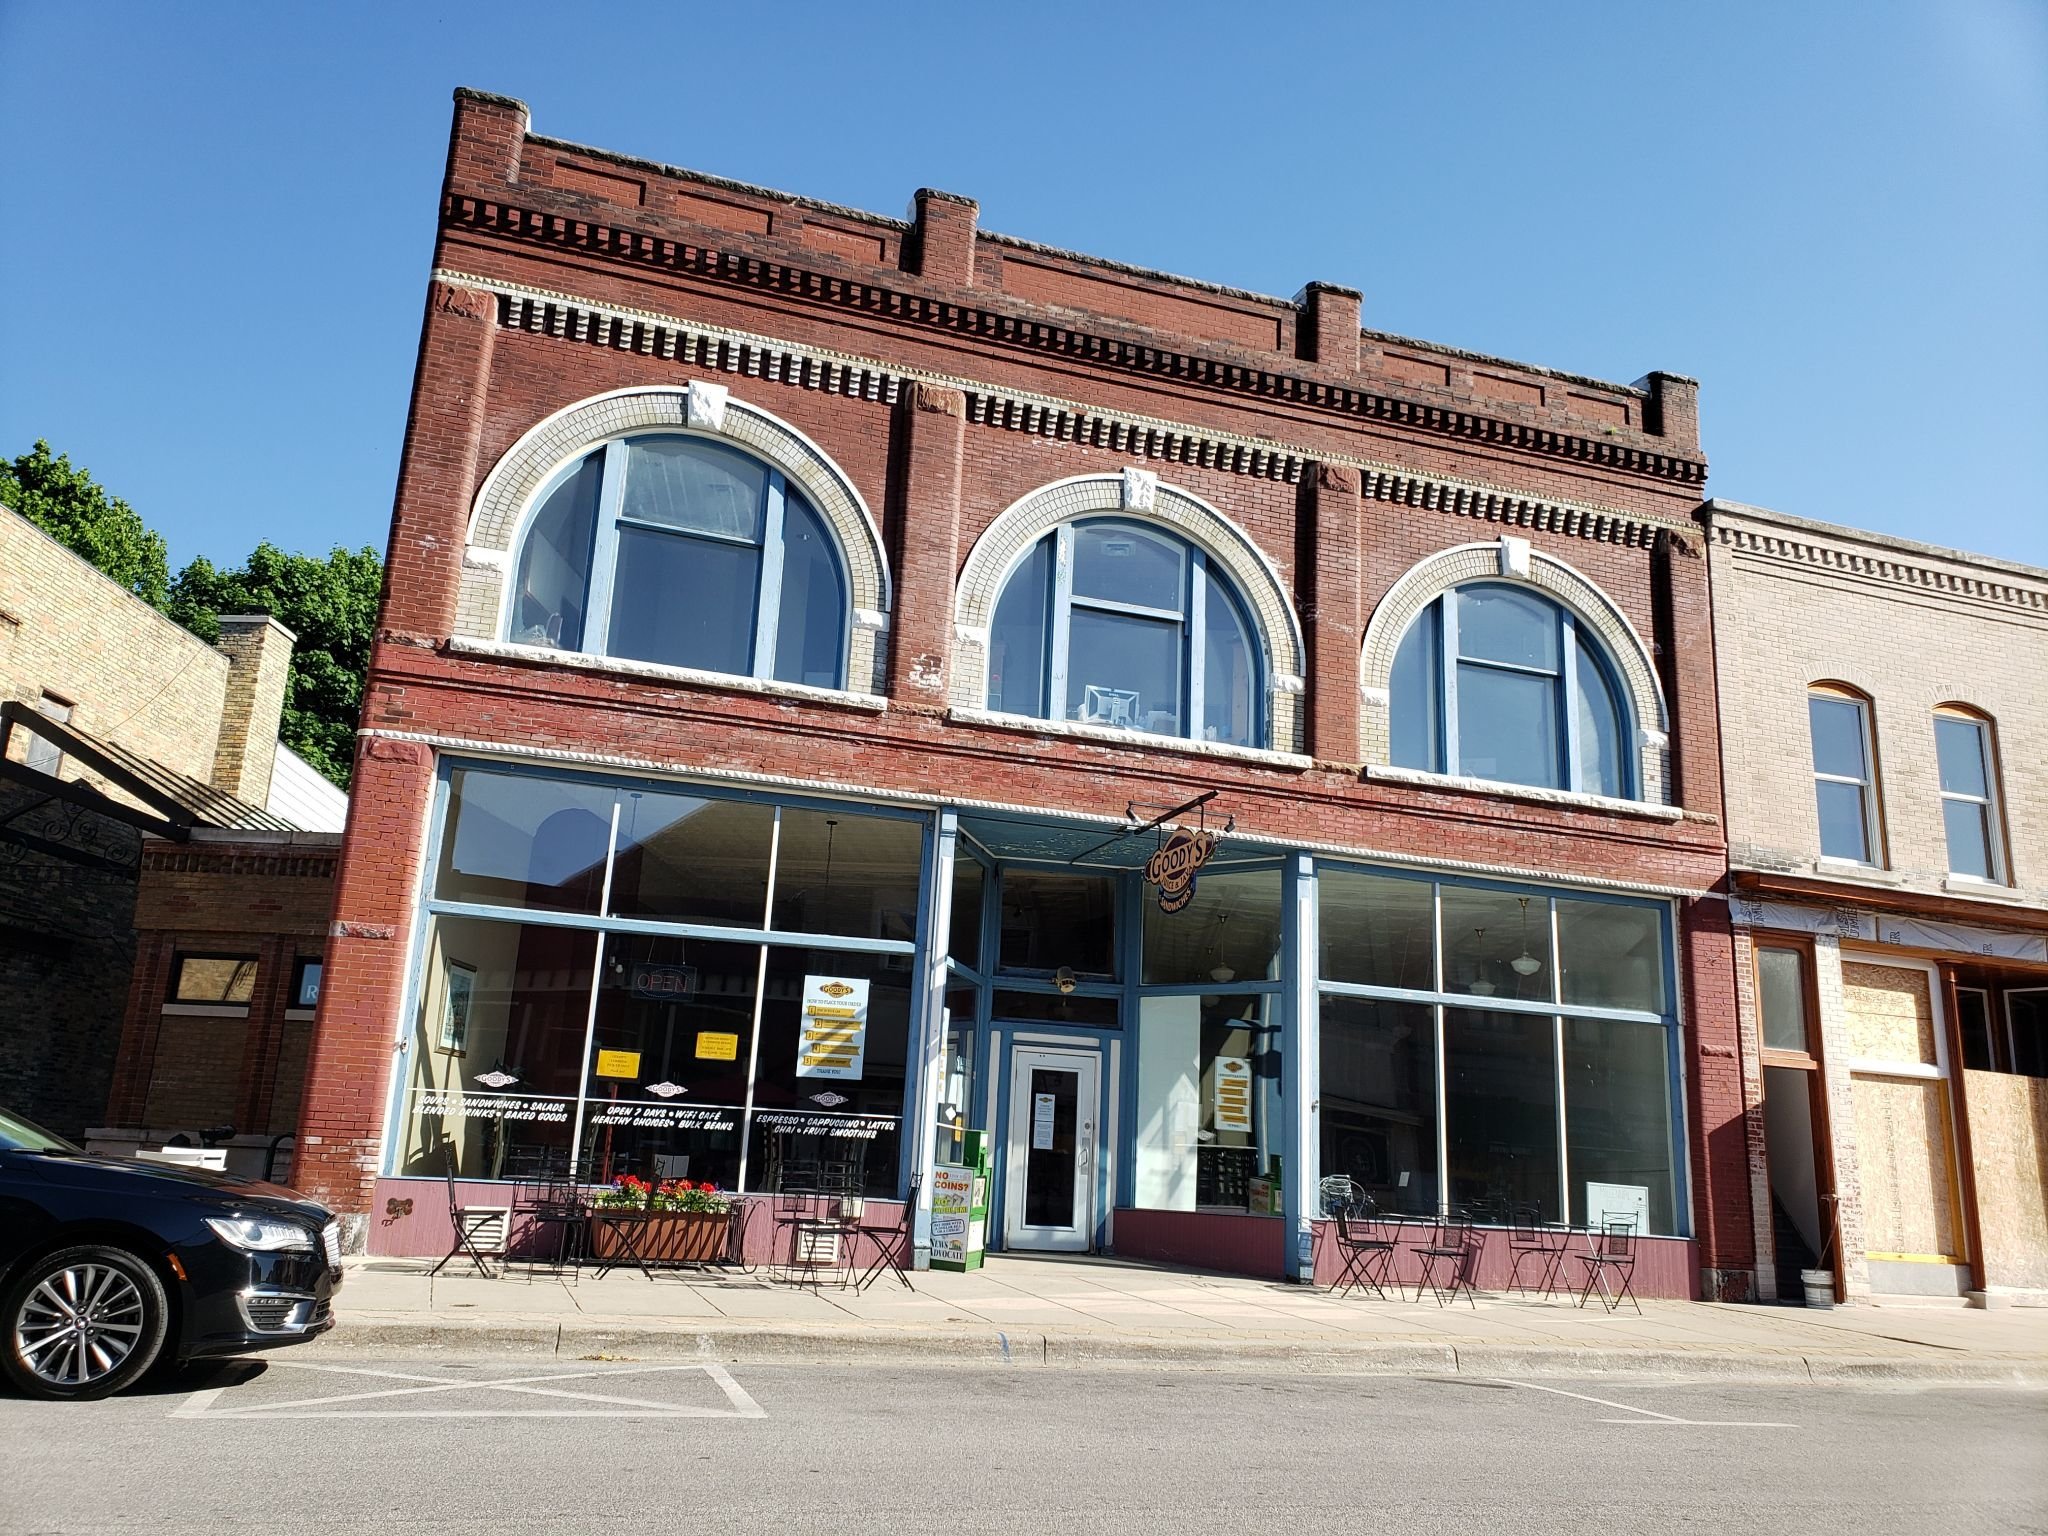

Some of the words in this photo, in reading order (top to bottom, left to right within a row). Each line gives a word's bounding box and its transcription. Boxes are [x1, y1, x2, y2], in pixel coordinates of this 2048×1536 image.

[1152, 838, 1203, 878] GOODY'S
[638, 974, 688, 992] OPEN
[418, 1096, 449, 1106] SOUPS
[458, 1098, 522, 1110] SANDWICHES
[530, 1102, 566, 1112] SALADS
[412, 1106, 456, 1116] BLENDED
[459, 1108, 496, 1118] DRINKS
[504, 1111, 535, 1120] BAKED
[538, 1112, 568, 1122] GOODS
[607, 1107, 633, 1116] OPEN
[643, 1108, 667, 1118] DAYS
[591, 1116, 632, 1125] HEALTHY
[633, 1117, 670, 1127] CHOICES
[678, 1120, 702, 1129] BULK
[703, 1121, 734, 1131] BEANS
[756, 1115, 799, 1125] ESPRESSO
[807, 1118, 859, 1128] CAPPUCCINO
[774, 1125, 795, 1133] CHAI
[803, 1127, 828, 1135] FRUIT
[830, 1128, 877, 1139] SMOOTHIES
[935, 1171, 949, 1179] NO
[934, 1181, 968, 1191] COINS?
